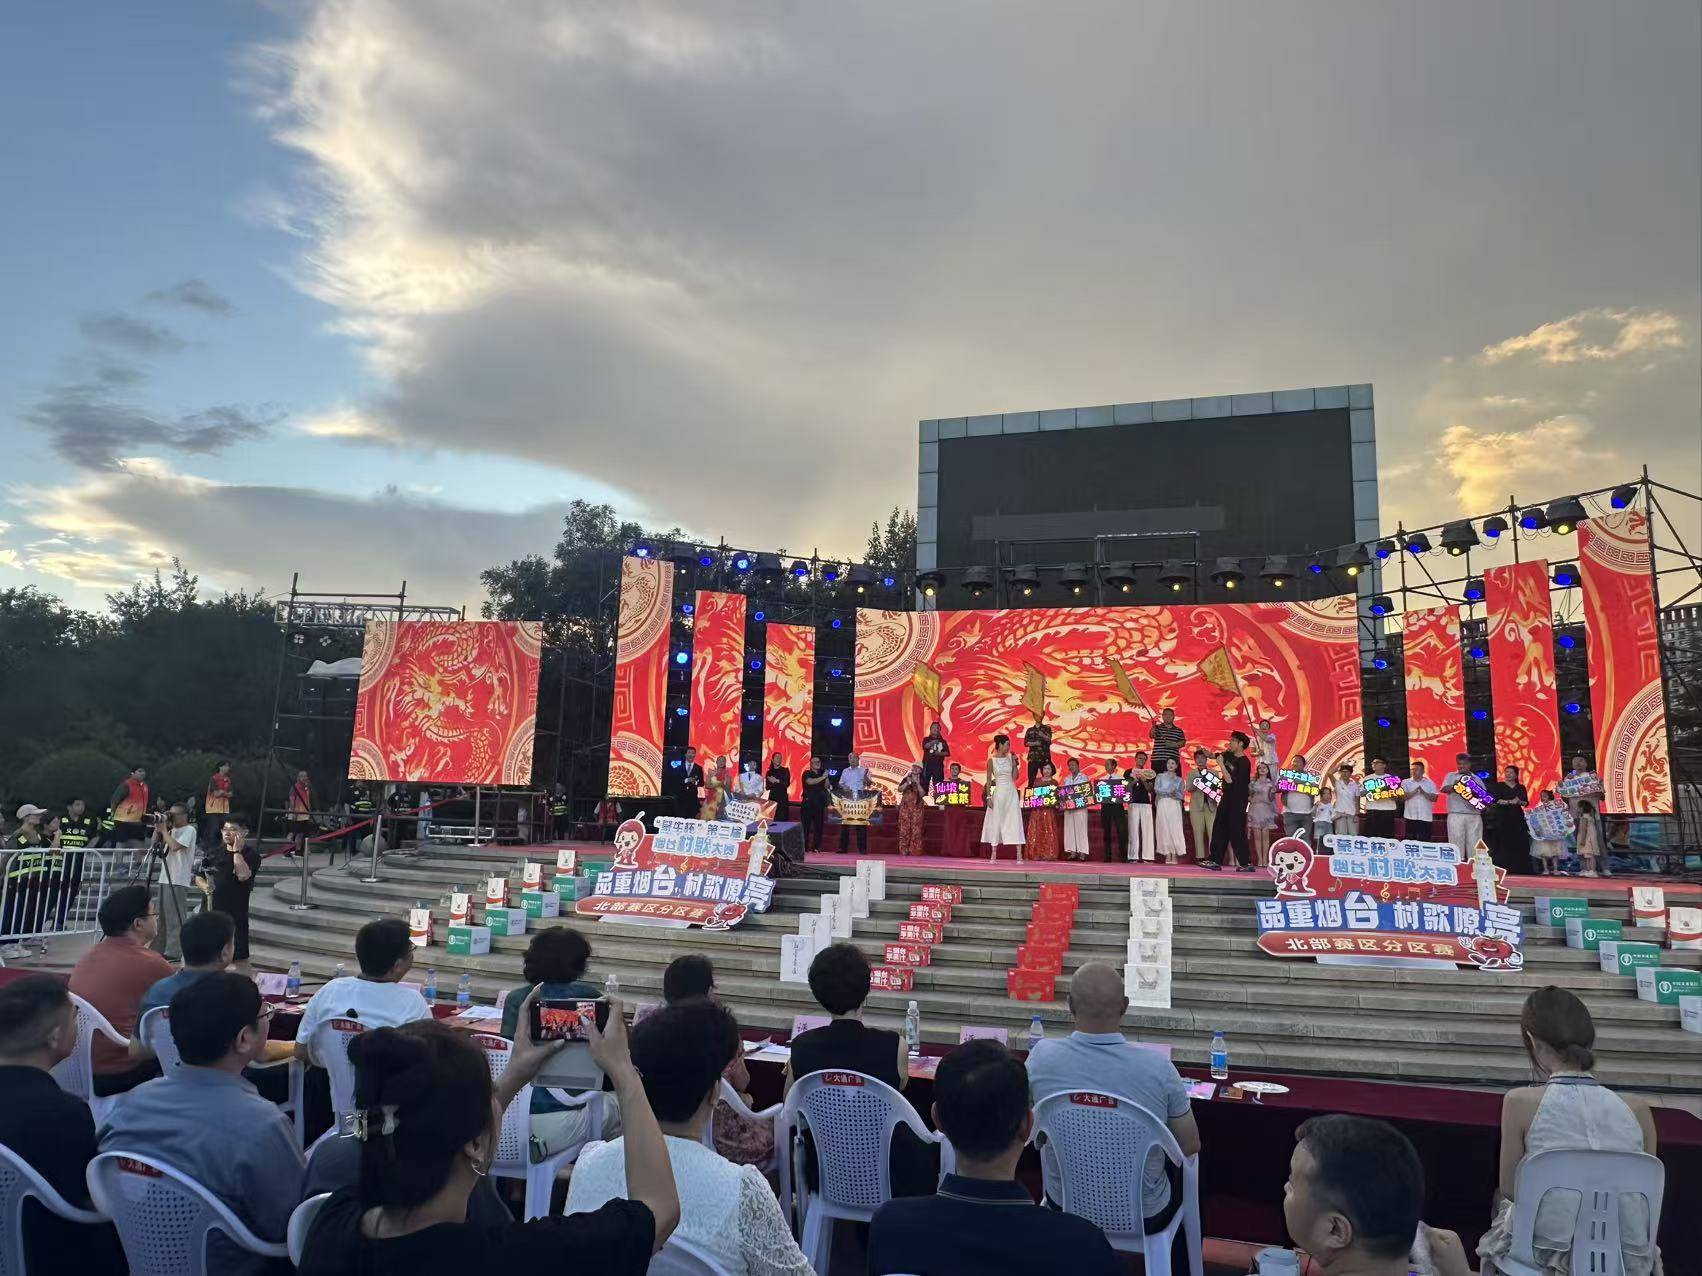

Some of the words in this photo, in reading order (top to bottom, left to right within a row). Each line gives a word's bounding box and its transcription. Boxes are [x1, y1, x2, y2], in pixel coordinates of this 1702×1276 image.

[1333, 857, 1455, 881] 烟台村歌大赛
[1286, 938, 1454, 956] 北部赛区分区赛
